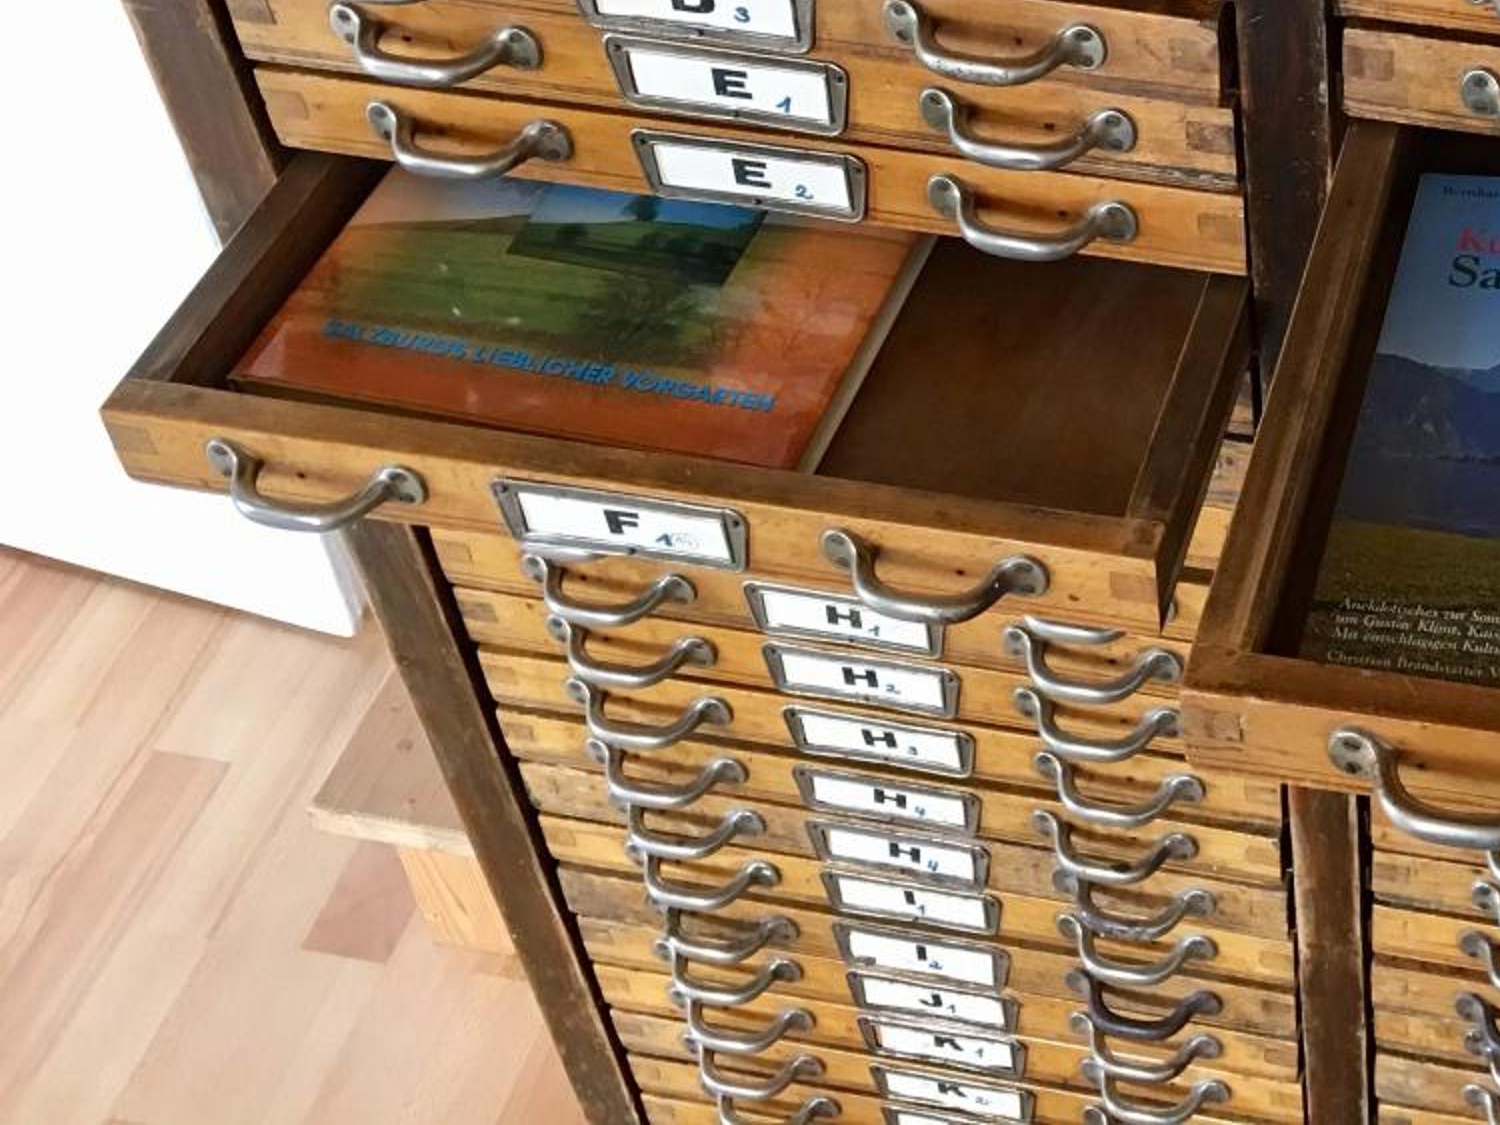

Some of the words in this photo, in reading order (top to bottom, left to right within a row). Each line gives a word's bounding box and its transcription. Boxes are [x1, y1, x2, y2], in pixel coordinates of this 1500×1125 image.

[732, 6, 752, 24] 3
[711, 68, 753, 100] E
[775, 96, 792, 114] 1
[732, 158, 772, 189] E
[794, 184, 814, 200] 2
[603, 508, 640, 535] F
[826, 605, 862, 628] H
[841, 666, 879, 687] H
[861, 728, 897, 748] H
[873, 788, 907, 810] H
[889, 842, 921, 864] H
